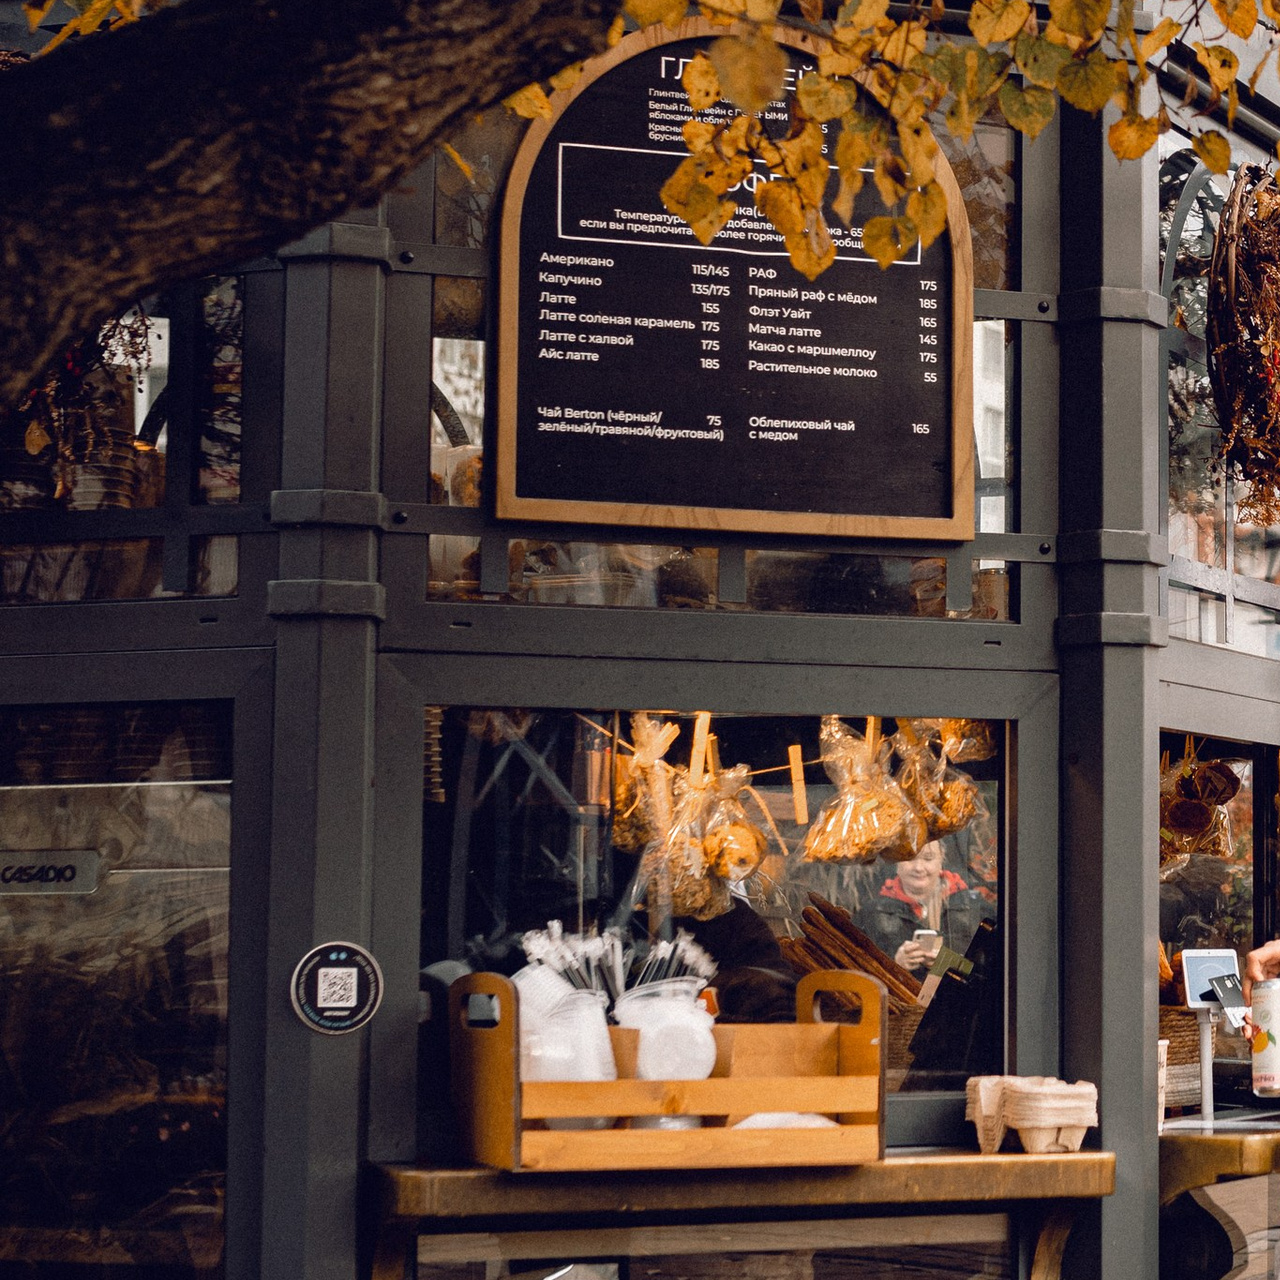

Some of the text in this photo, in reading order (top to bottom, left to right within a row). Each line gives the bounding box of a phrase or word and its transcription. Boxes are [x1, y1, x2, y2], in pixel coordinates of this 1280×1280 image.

[649, 88, 690, 99] Глинтвей
[648, 101, 678, 111] Белый
[648, 111, 693, 122] яблоками
[648, 122, 682, 133] Красны
[579, 220, 607, 229] если
[609, 222, 624, 231] вы
[626, 223, 696, 236] предпочита
[748, 232, 786, 243] горячи
[727, 220, 775, 231] добавле
[540, 252, 614, 267] Американо
[692, 264, 730, 277] 115/145
[748, 267, 777, 279] РАФ
[538, 272, 602, 286] Капучино
[691, 283, 730, 296] 135/175
[920, 280, 937, 291] 175
[539, 292, 577, 304] Латте
[749, 286, 877, 305] Пряный раф с мёдом
[701, 302, 720, 314] 155
[919, 298, 937, 309] 185
[749, 306, 812, 319] Флэт Уайт
[539, 310, 696, 330] Латте соленая карамель
[701, 320, 720, 332] 175
[920, 317, 937, 328] 165
[748, 323, 822, 338] Матча латте
[538, 330, 634, 346] Латте с халвой
[919, 334, 937, 345] 145
[701, 340, 720, 351] 175
[748, 340, 877, 361] Какао с маршмеллоу
[538, 348, 600, 362] Айс латте
[920, 352, 937, 363] 175
[700, 358, 720, 370] 185
[748, 360, 878, 378] Растительное молоко
[924, 372, 937, 383] 55
[538, 406, 663, 423] Чай Berton (чёрный/
[707, 415, 722, 426] 75
[749, 416, 856, 431] Облепиховый чай
[912, 424, 930, 434] 165
[749, 431, 798, 442] с медом
[1, 864, 76, 884] CASADIO
